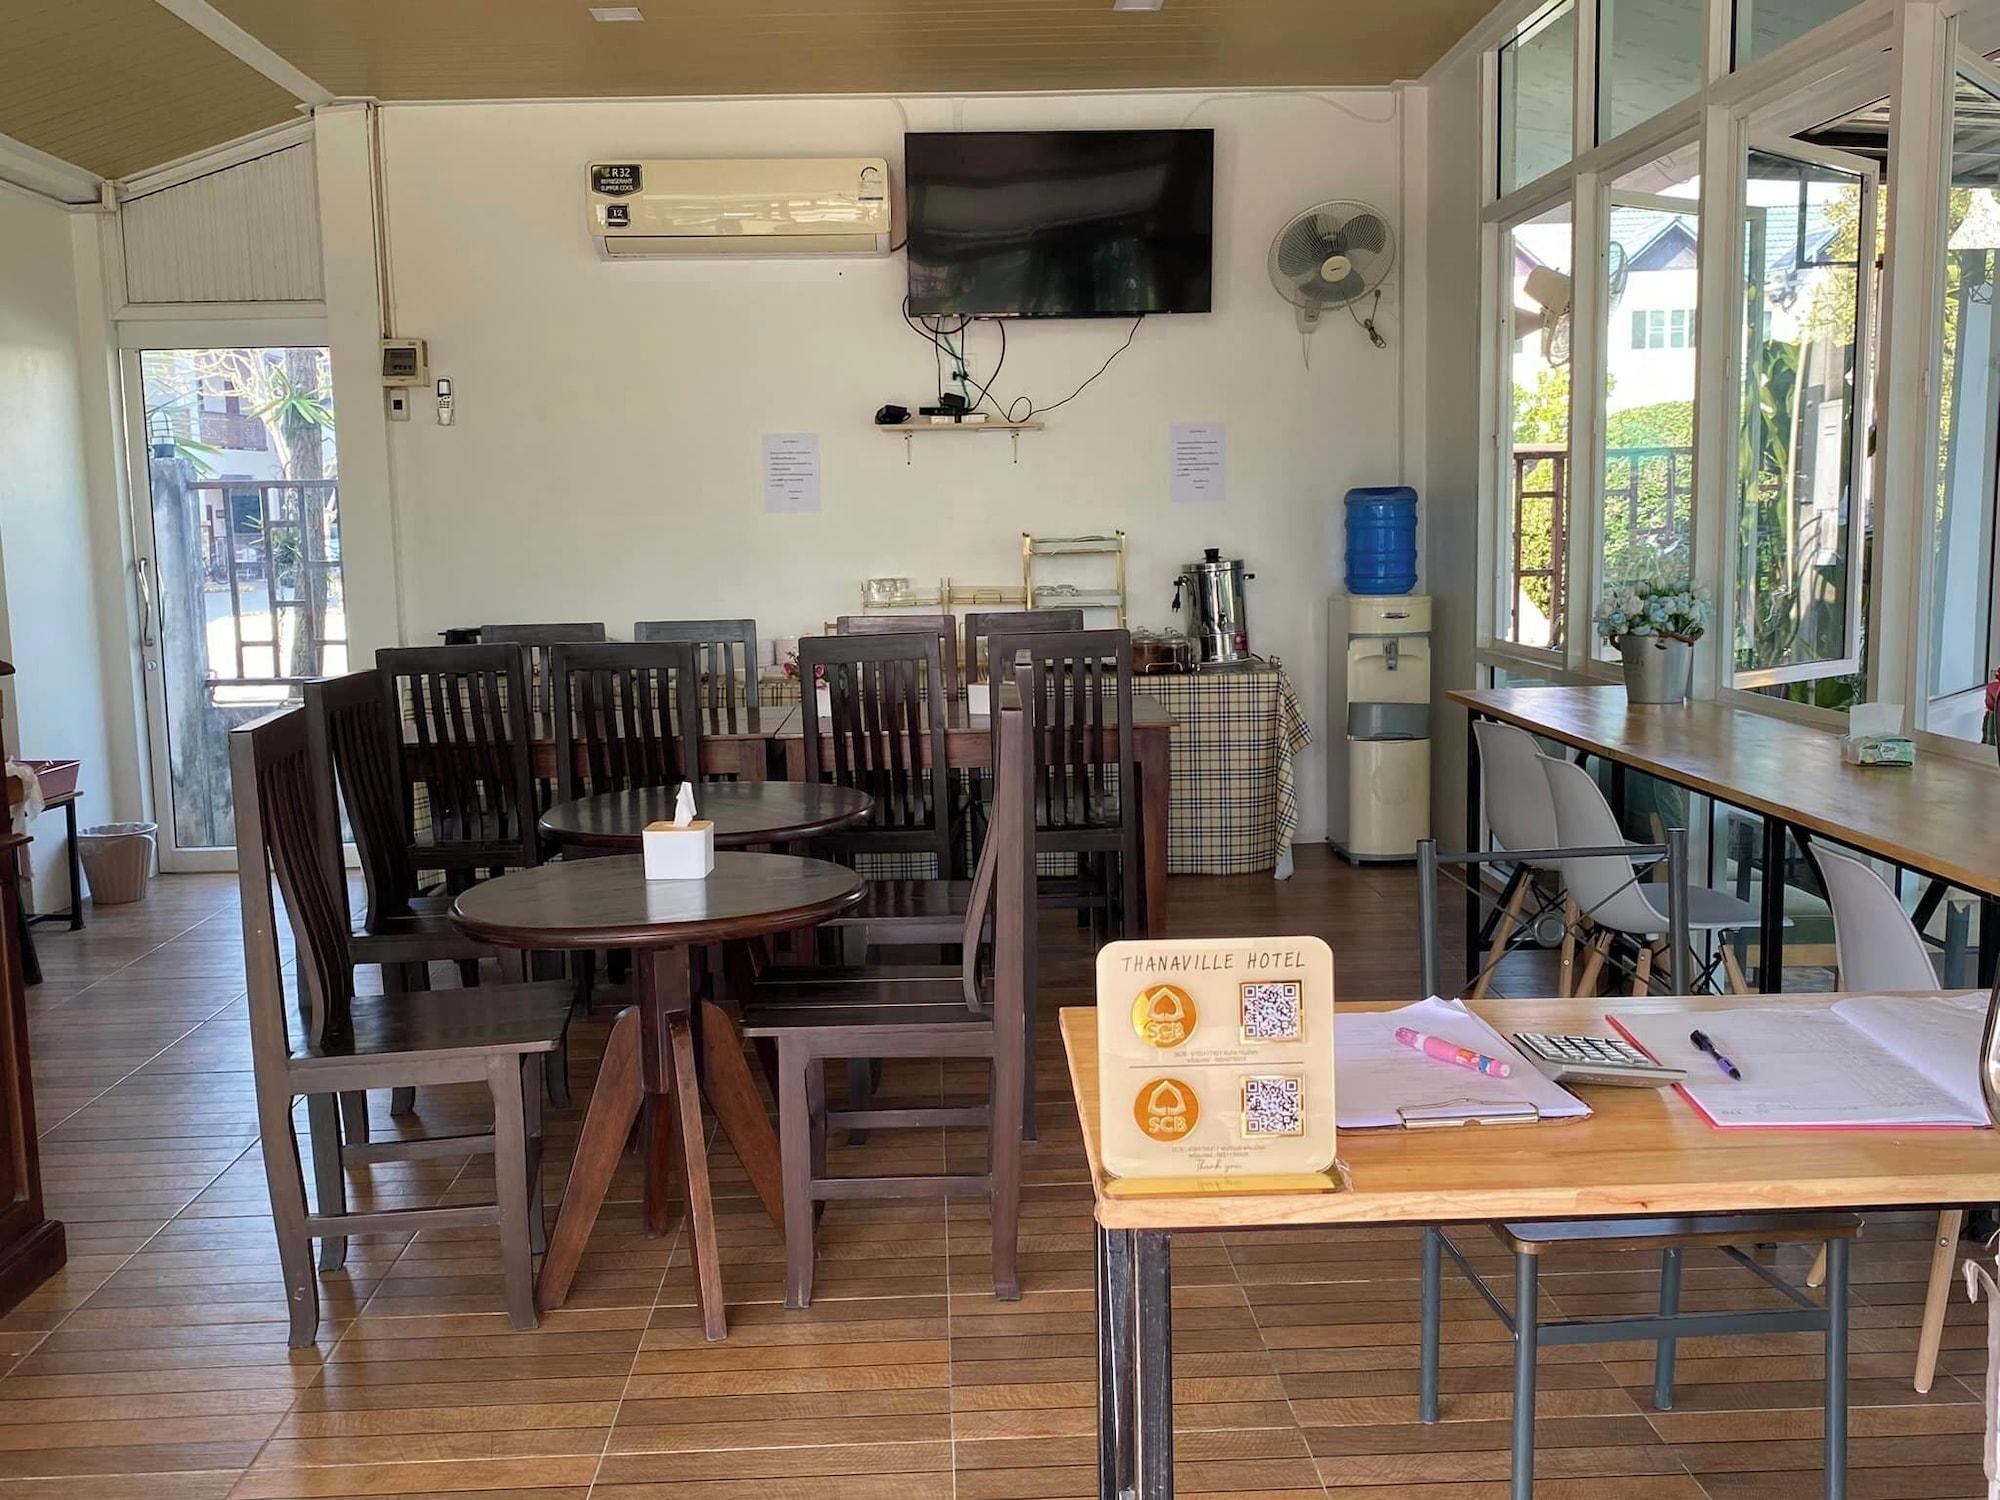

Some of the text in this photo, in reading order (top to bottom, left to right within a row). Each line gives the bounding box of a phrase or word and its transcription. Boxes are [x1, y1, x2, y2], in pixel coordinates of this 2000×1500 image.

[613, 209, 623, 217] 12
[1121, 951, 1305, 972] THANAVILLE HOTEL
[1146, 1021, 1185, 1040] SCB
[1148, 1116, 1187, 1134] SCB
